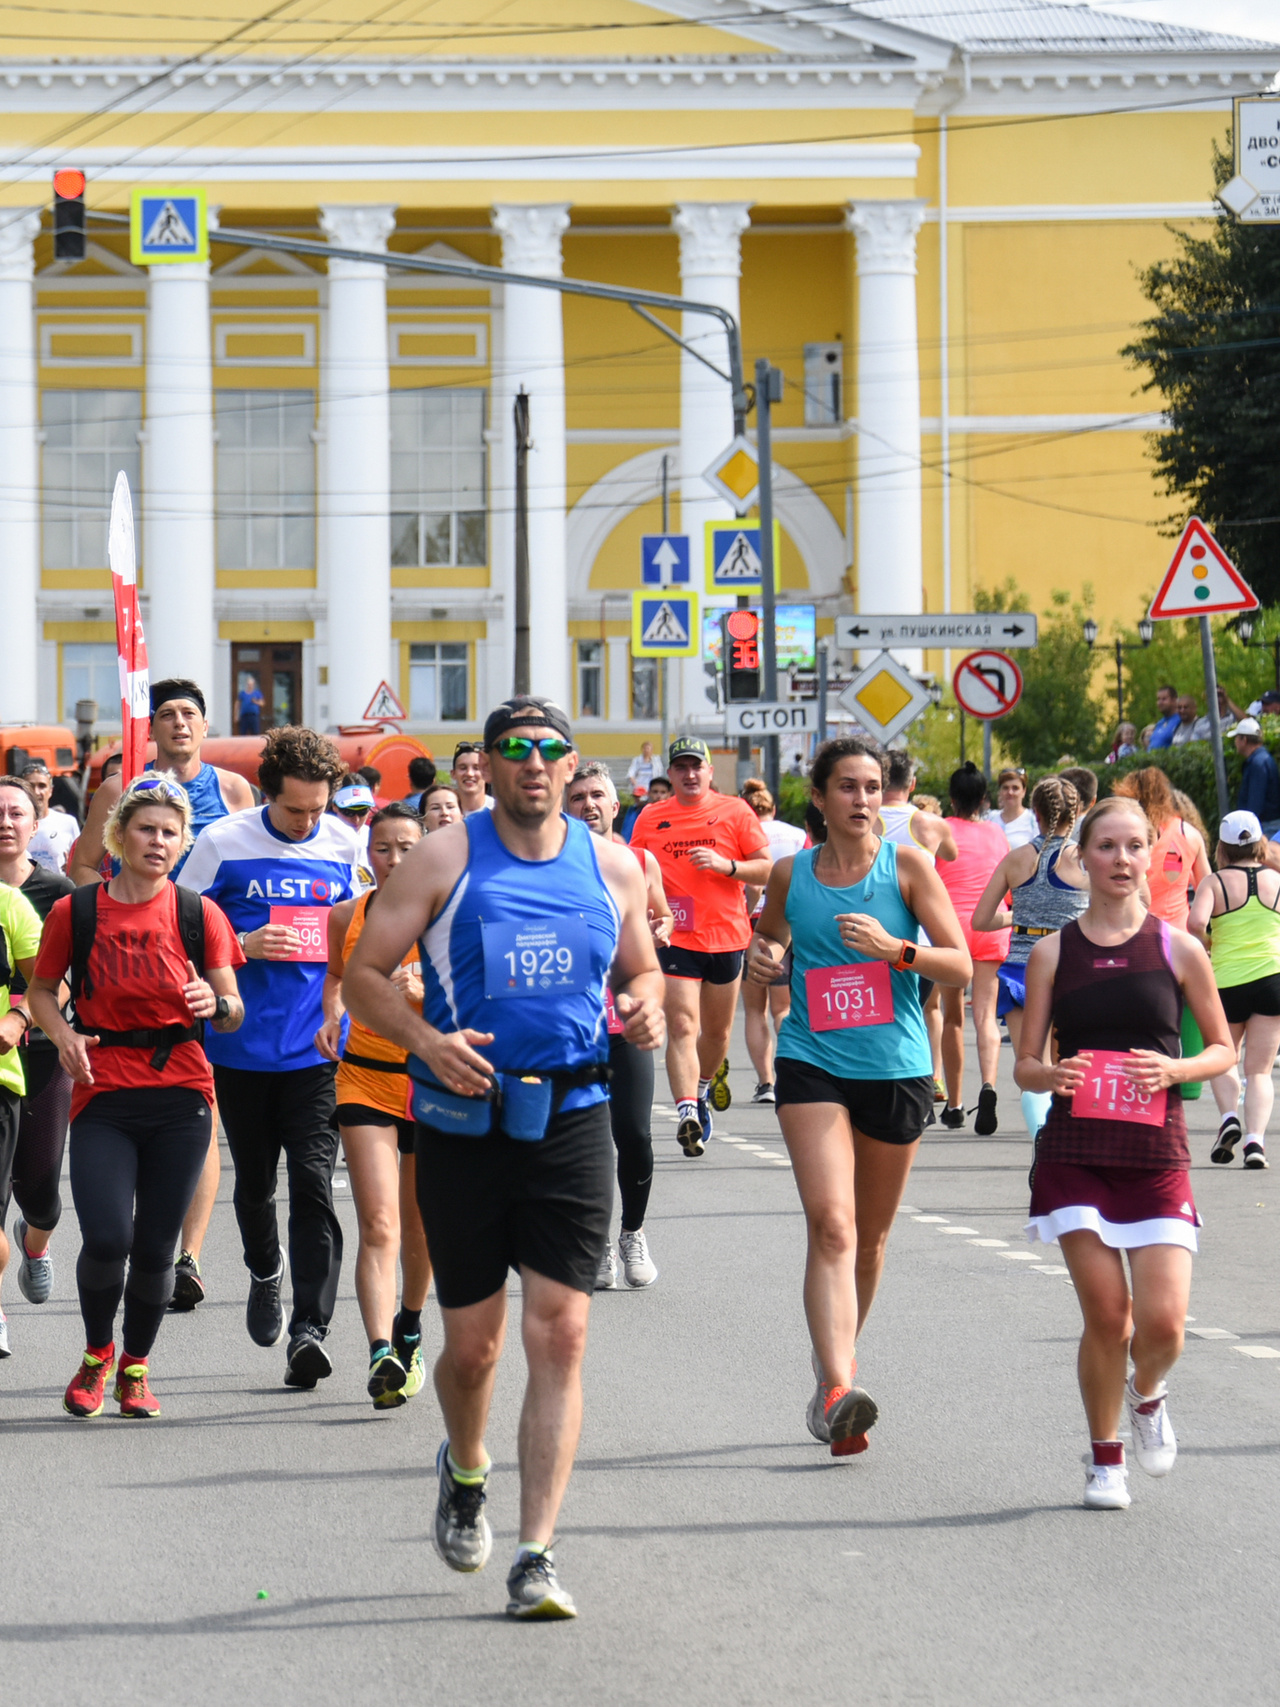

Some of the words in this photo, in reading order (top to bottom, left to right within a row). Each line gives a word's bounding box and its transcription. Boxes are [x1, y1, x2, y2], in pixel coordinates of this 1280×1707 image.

[1248, 136, 1280, 150] ДВО
[1261, 156, 1280, 168] «С
[881, 629, 897, 639] ул.
[900, 626, 992, 638] ПУШКИНСКАЯ
[733, 641, 759, 669] 36
[740, 708, 807, 730] СТОП
[246, 878, 342, 901] ALSTOM
[672, 909, 687, 922] 20
[293, 928, 322, 947] 96
[96, 929, 178, 989] NIKE
[504, 947, 573, 977] 1929
[821, 986, 876, 1013] 1031
